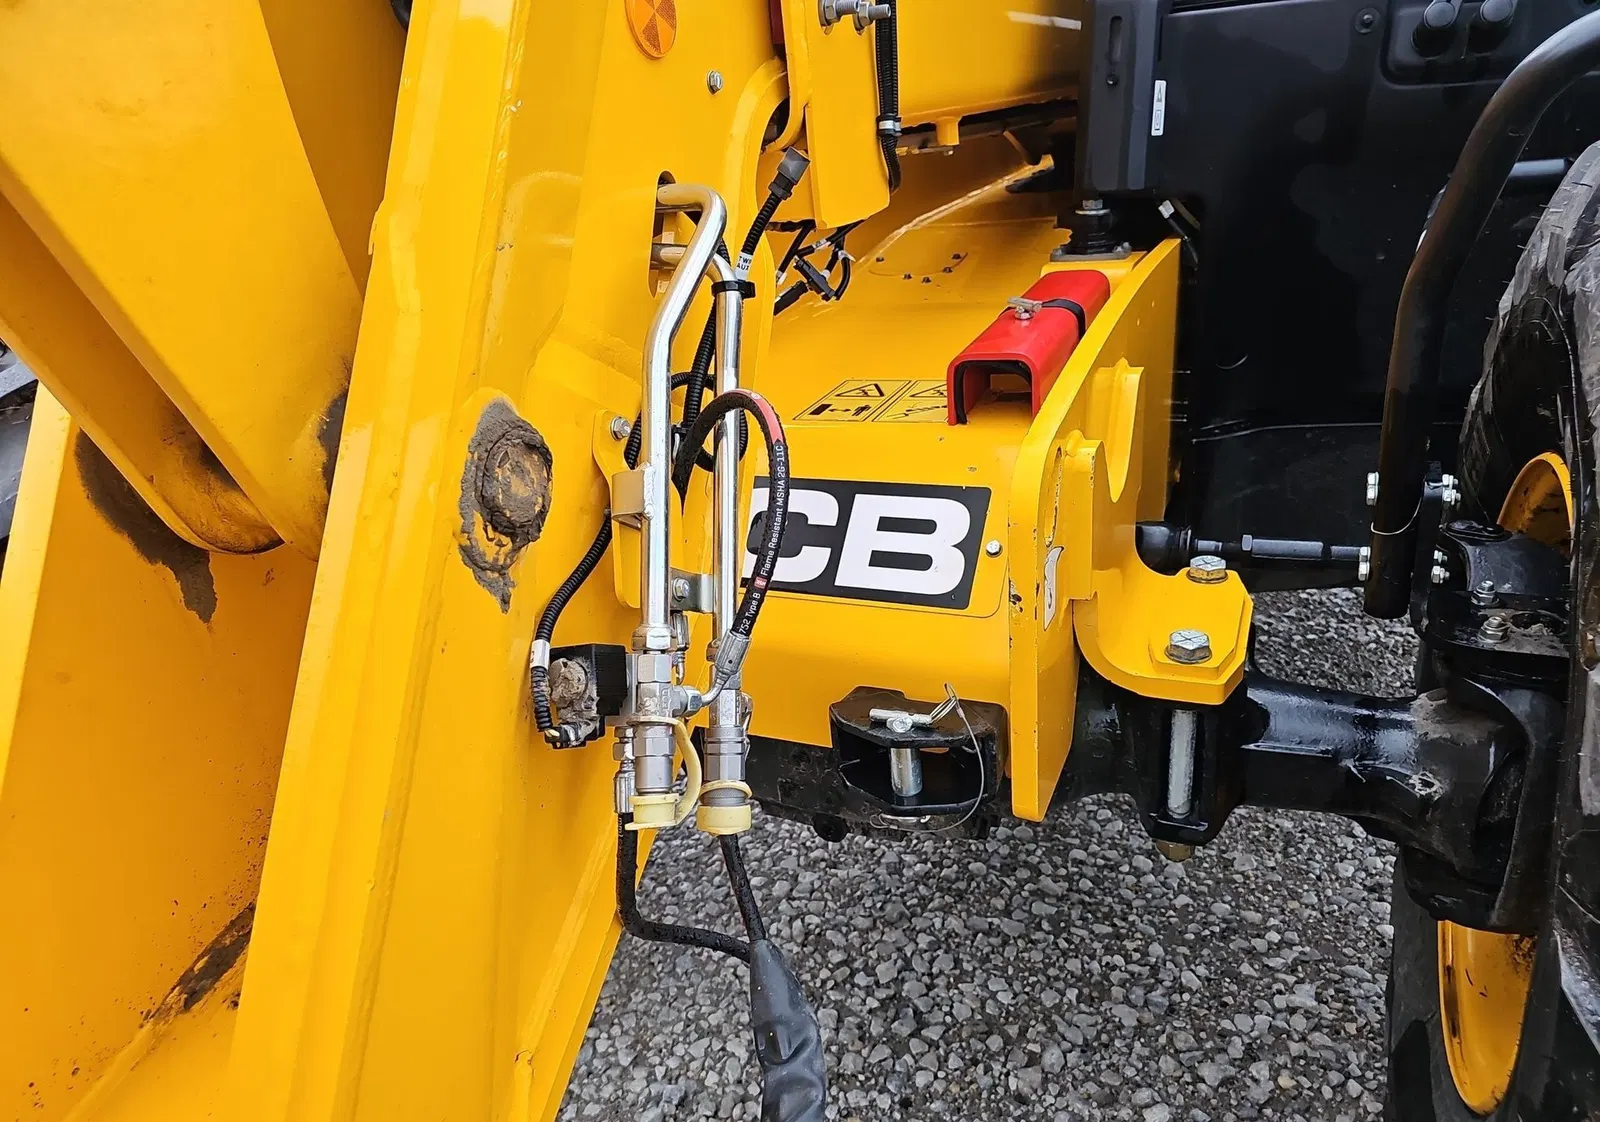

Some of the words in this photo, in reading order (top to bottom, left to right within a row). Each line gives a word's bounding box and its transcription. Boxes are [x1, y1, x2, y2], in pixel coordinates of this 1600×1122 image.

[775, 445, 786, 478] 2G-11C
[776, 480, 785, 506] MSHA
[768, 508, 783, 549] Resistant
[760, 551, 774, 576] Flame
[745, 601, 758, 617] Type
